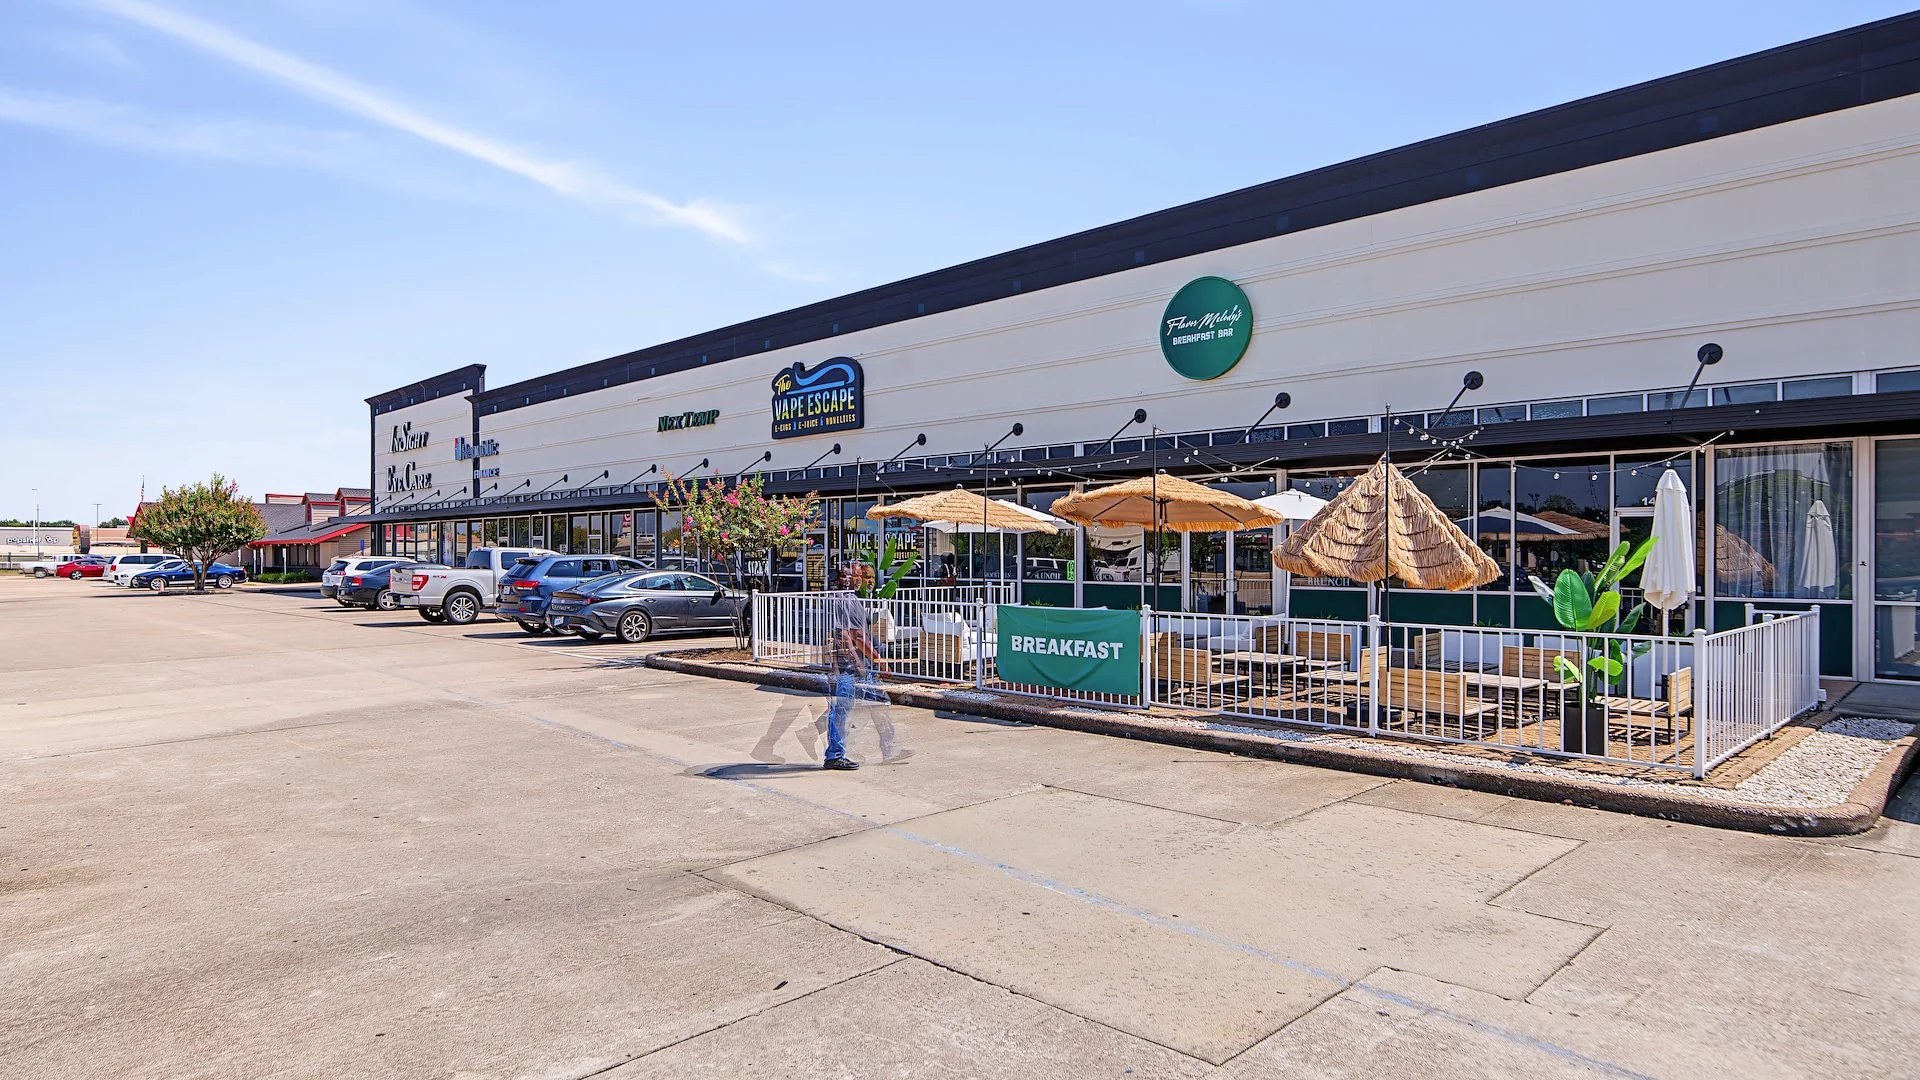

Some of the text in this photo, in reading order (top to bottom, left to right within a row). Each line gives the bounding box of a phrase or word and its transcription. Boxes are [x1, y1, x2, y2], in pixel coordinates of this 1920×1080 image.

[1172, 328, 1234, 346] BREAKFAST BAR
[775, 374, 792, 396] The
[774, 387, 855, 421] VAPE ESCAPE
[825, 413, 856, 426] NOVELTIES
[1307, 577, 1350, 587] BRUNCH
[1011, 635, 1124, 660] BREAKFAST
